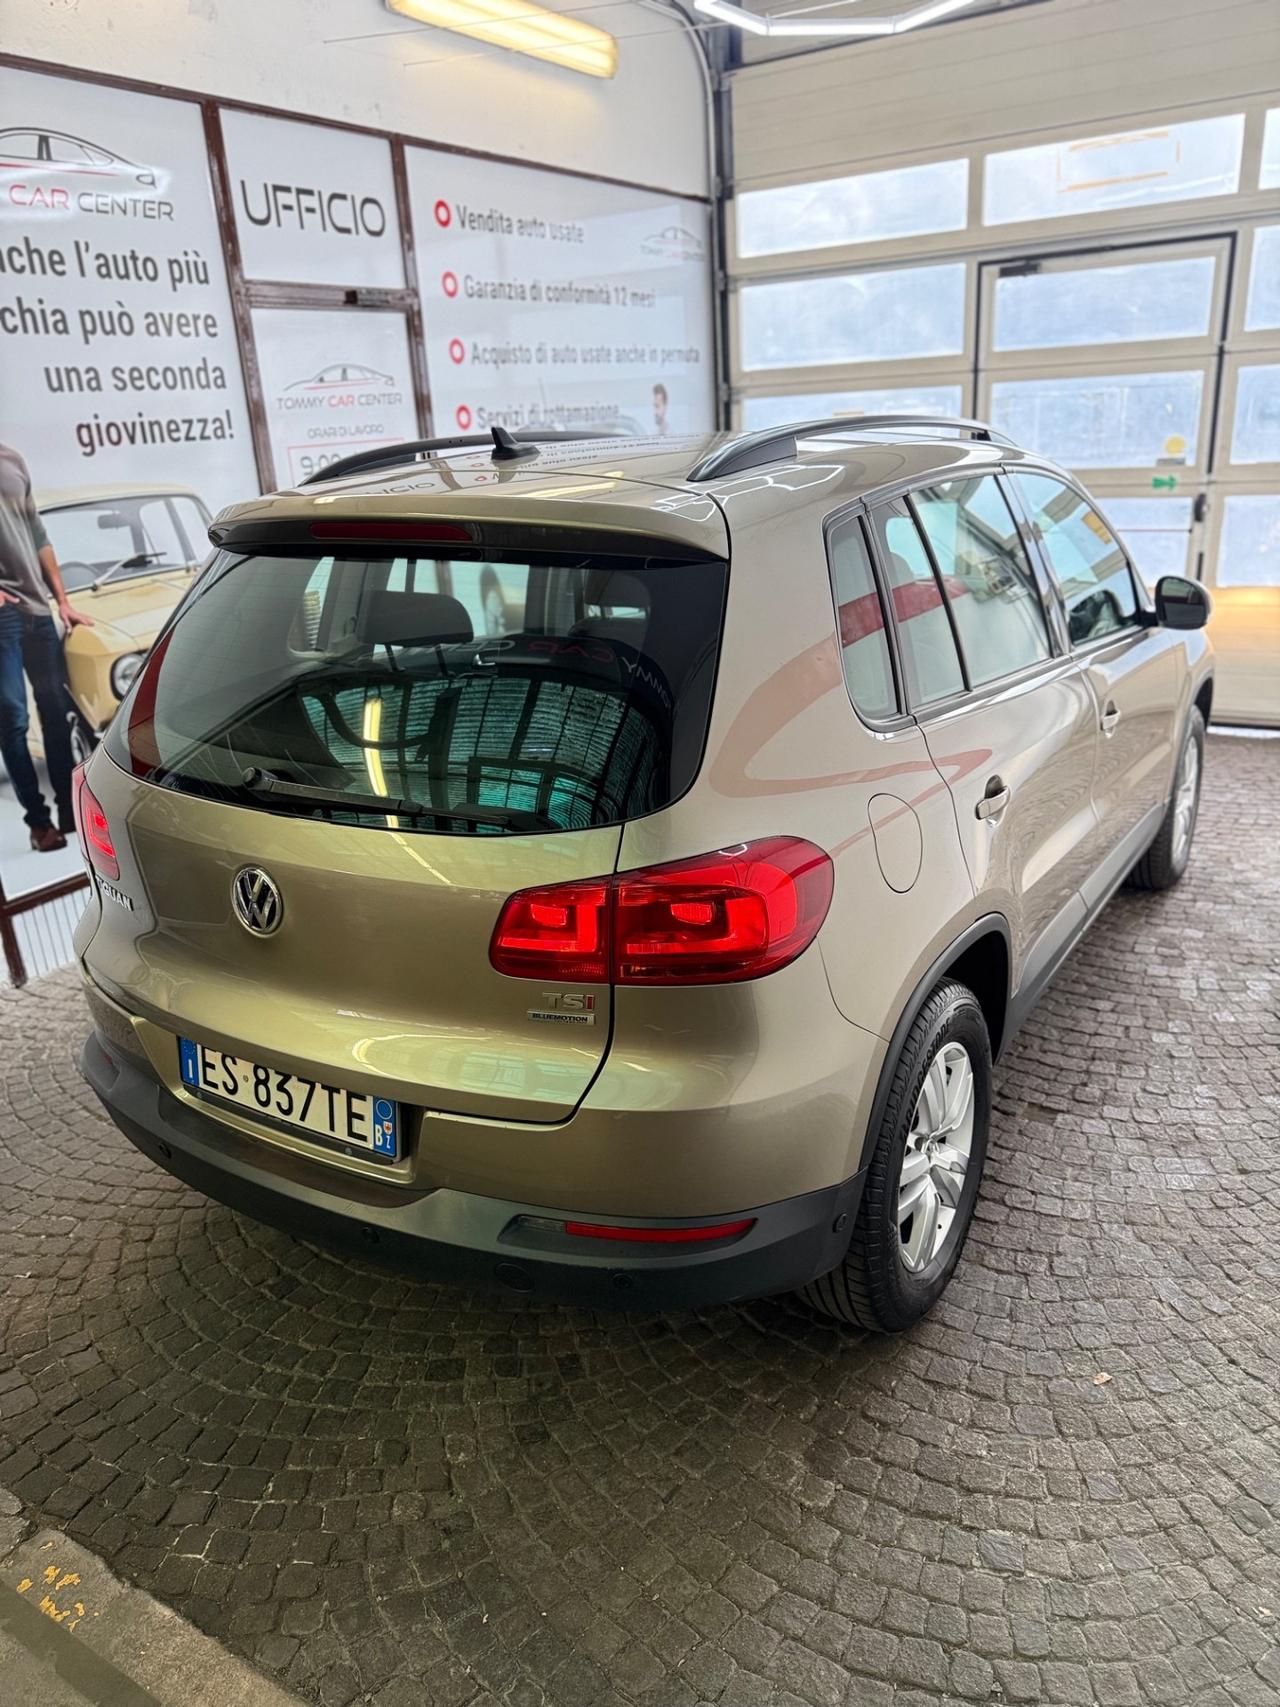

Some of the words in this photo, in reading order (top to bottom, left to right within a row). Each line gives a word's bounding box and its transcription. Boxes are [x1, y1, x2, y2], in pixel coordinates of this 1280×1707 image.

[8, 184, 70, 210] CAR
[77, 192, 174, 221] CENTER
[240, 179, 387, 238] UFFICIO
[456, 204, 513, 235] Vendita
[517, 216, 546, 239] auto
[550, 220, 585, 244] usate
[74, 240, 160, 282] l'auto
[167, 250, 210, 292] più
[463, 275, 527, 300] Garanzia
[528, 279, 544, 301] di
[614, 287, 628, 307] 12
[78, 300, 135, 345] può
[144, 311, 218, 338] avere
[44, 365, 103, 393] una
[111, 356, 227, 392] seconda
[471, 342, 532, 370] Acquisto
[535, 343, 548, 365] di
[551, 346, 578, 364] auto
[582, 346, 613, 364] usate
[616, 344, 647, 364] anche
[276, 395, 327, 410] TOMMY
[328, 394, 355, 408] CAR
[356, 392, 403, 407] CENTER
[476, 404, 525, 430] Servizi
[76, 408, 235, 458] giovinezza!
[532, 1013, 589, 1024] BLUEMOTION
[542, 991, 595, 1012] TSI
[201, 1046, 239, 1096] ES
[252, 1062, 369, 1144] 837TE
